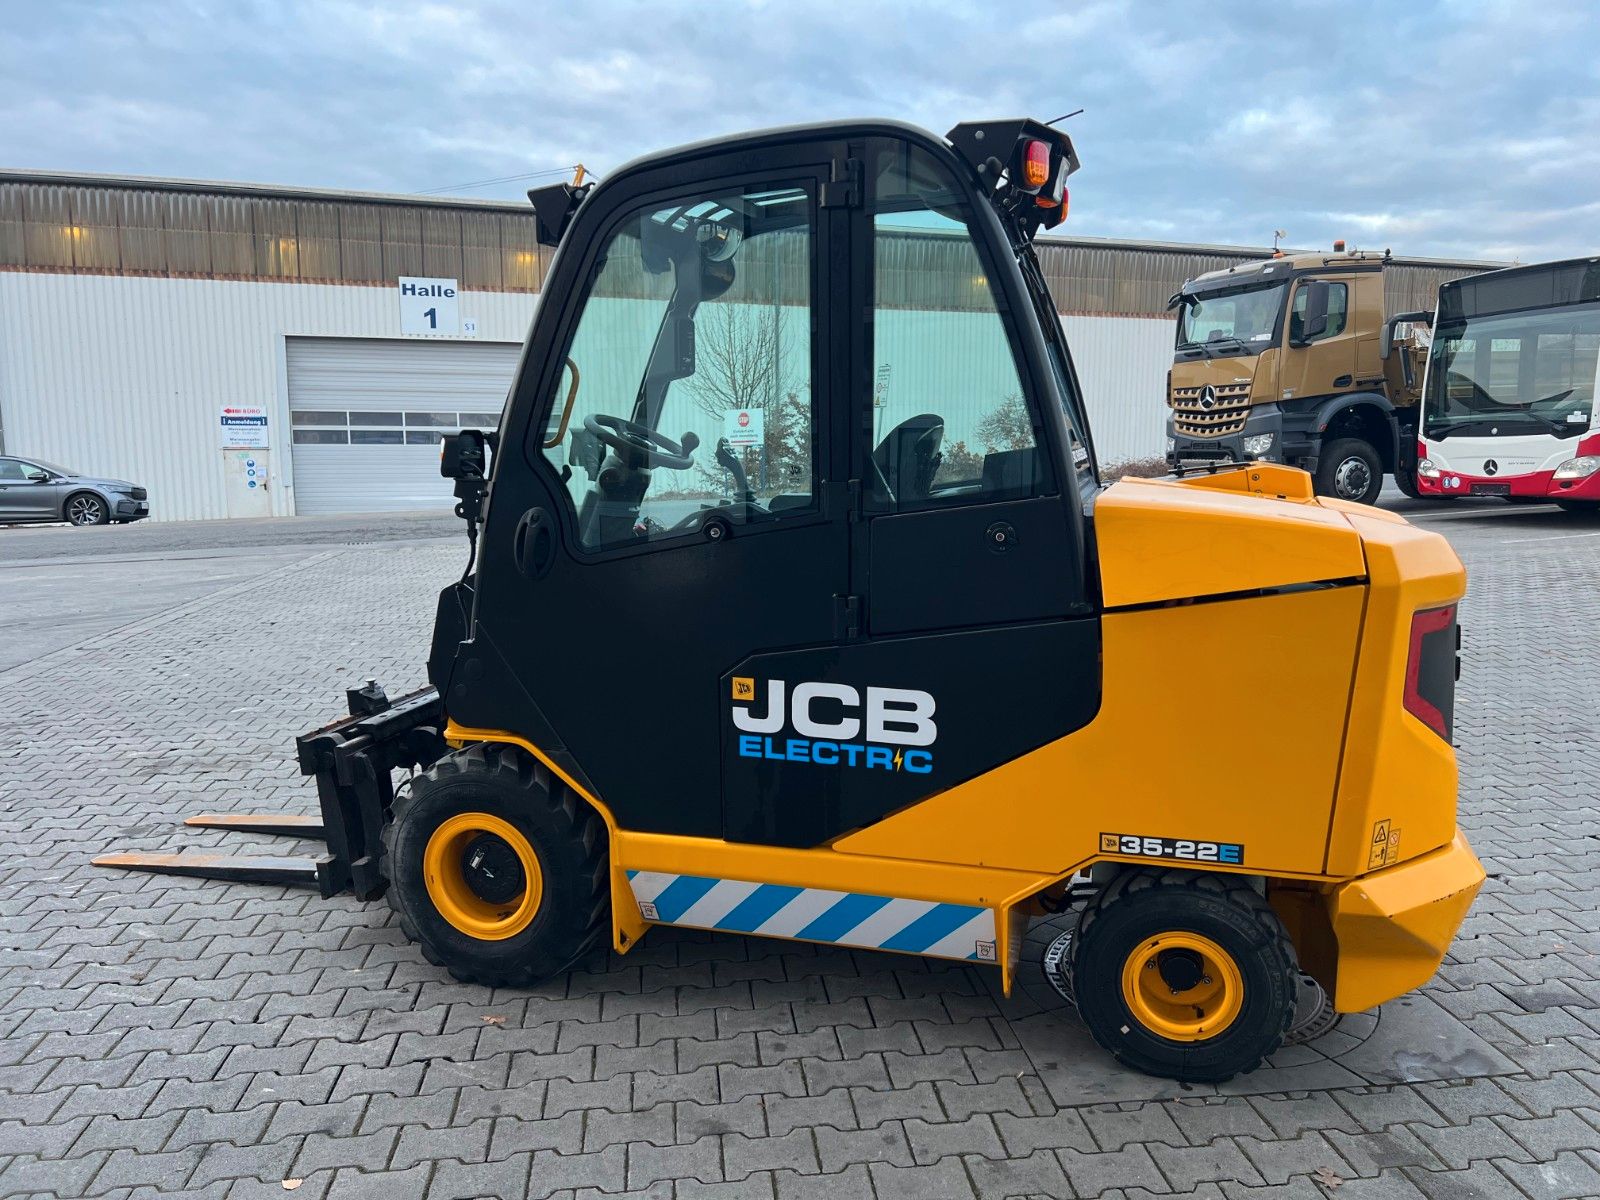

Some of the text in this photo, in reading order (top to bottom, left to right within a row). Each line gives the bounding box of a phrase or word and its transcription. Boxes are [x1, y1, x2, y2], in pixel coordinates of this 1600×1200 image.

[402, 283, 456, 298] Halle
[423, 307, 437, 329] 1
[735, 681, 753, 695] JCB
[732, 679, 938, 747] JCB
[1120, 836, 1240, 863] 35-22E
